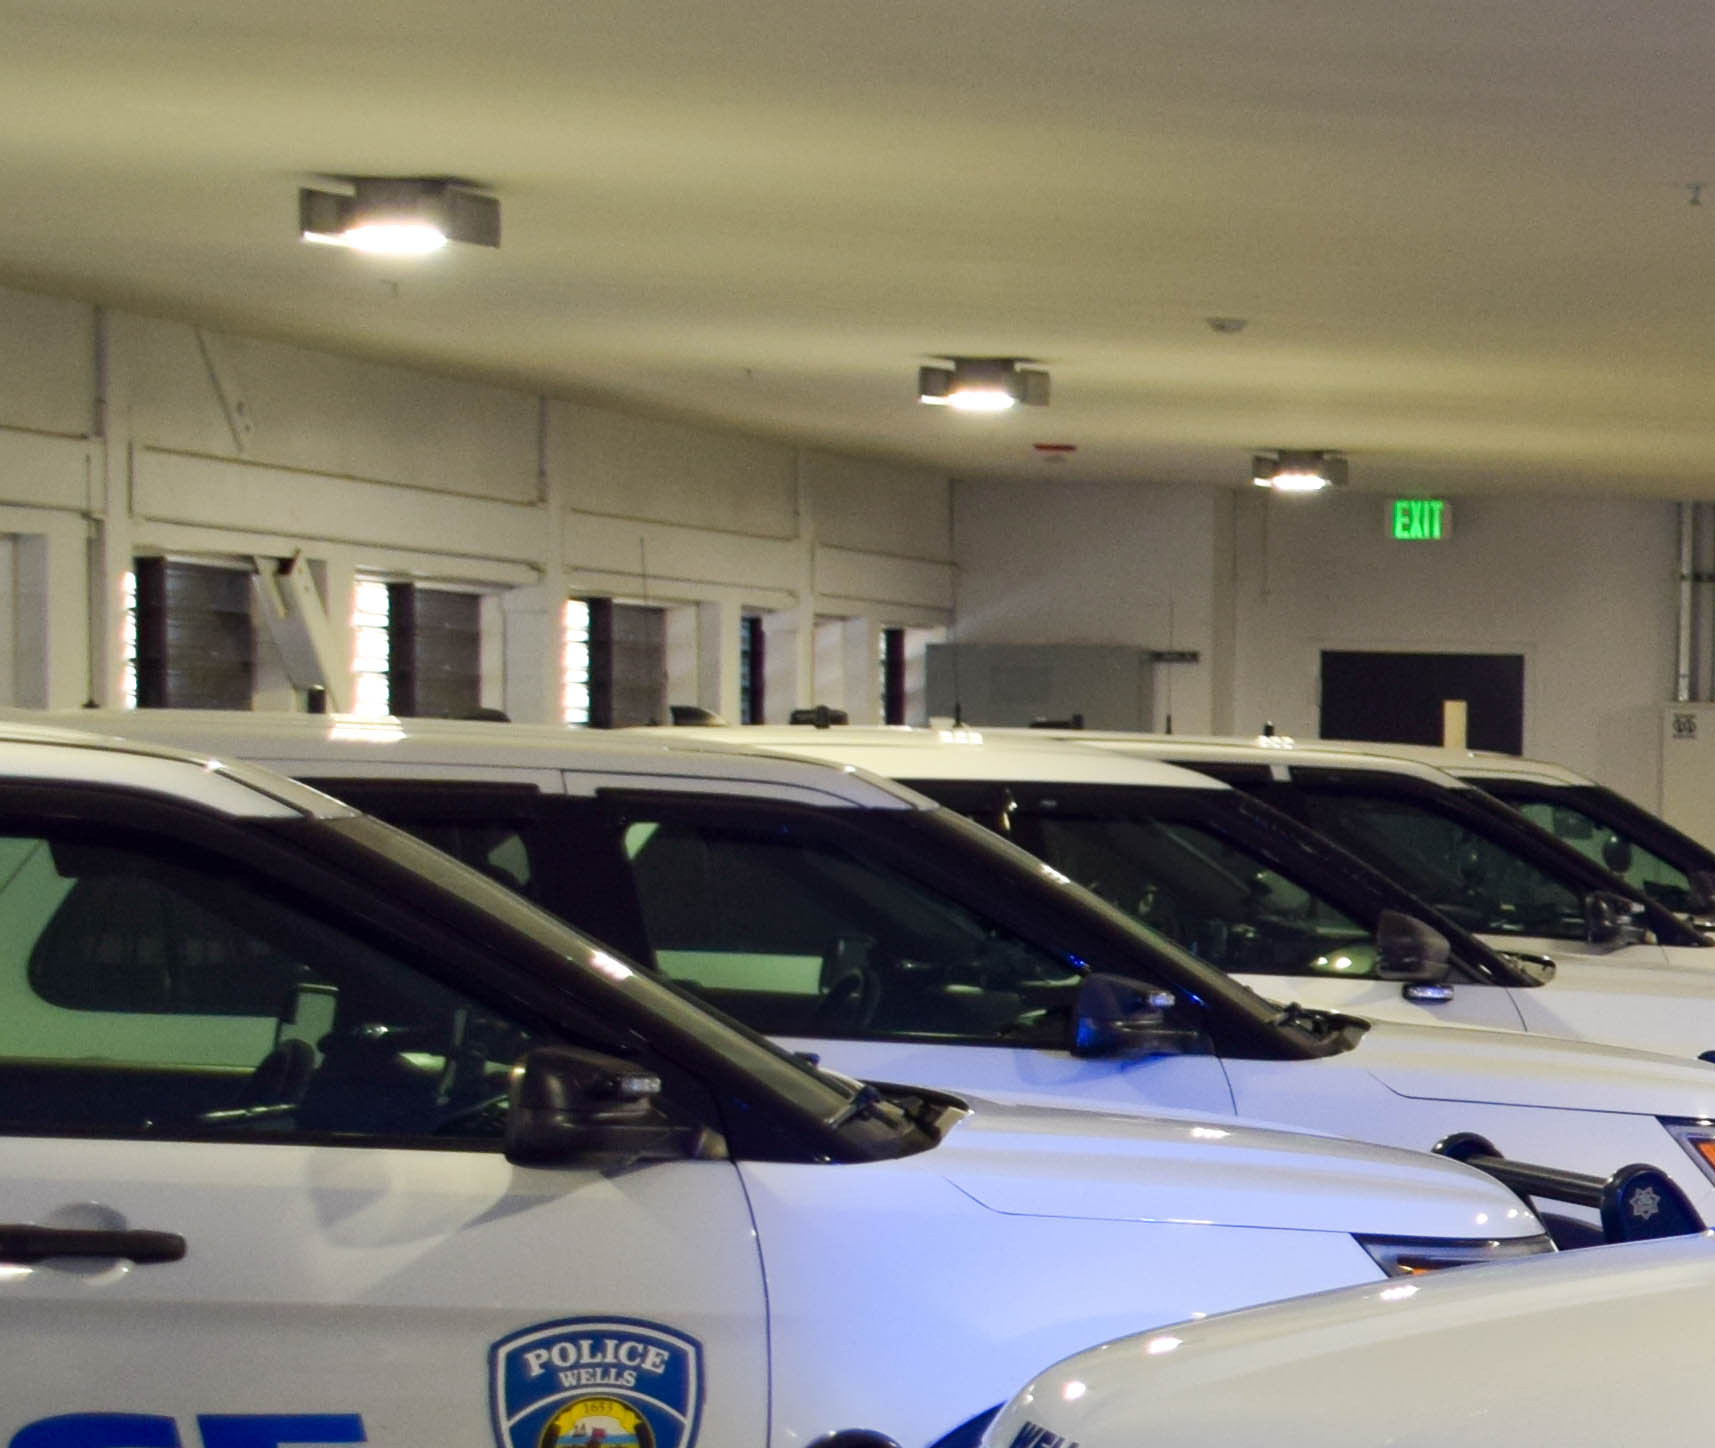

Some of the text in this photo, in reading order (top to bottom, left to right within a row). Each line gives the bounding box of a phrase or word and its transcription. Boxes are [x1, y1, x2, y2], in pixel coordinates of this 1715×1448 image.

[1394, 500, 1443, 540] EXIT
[523, 1338, 670, 1377] POLICE
[559, 1367, 637, 1388] WELLS
